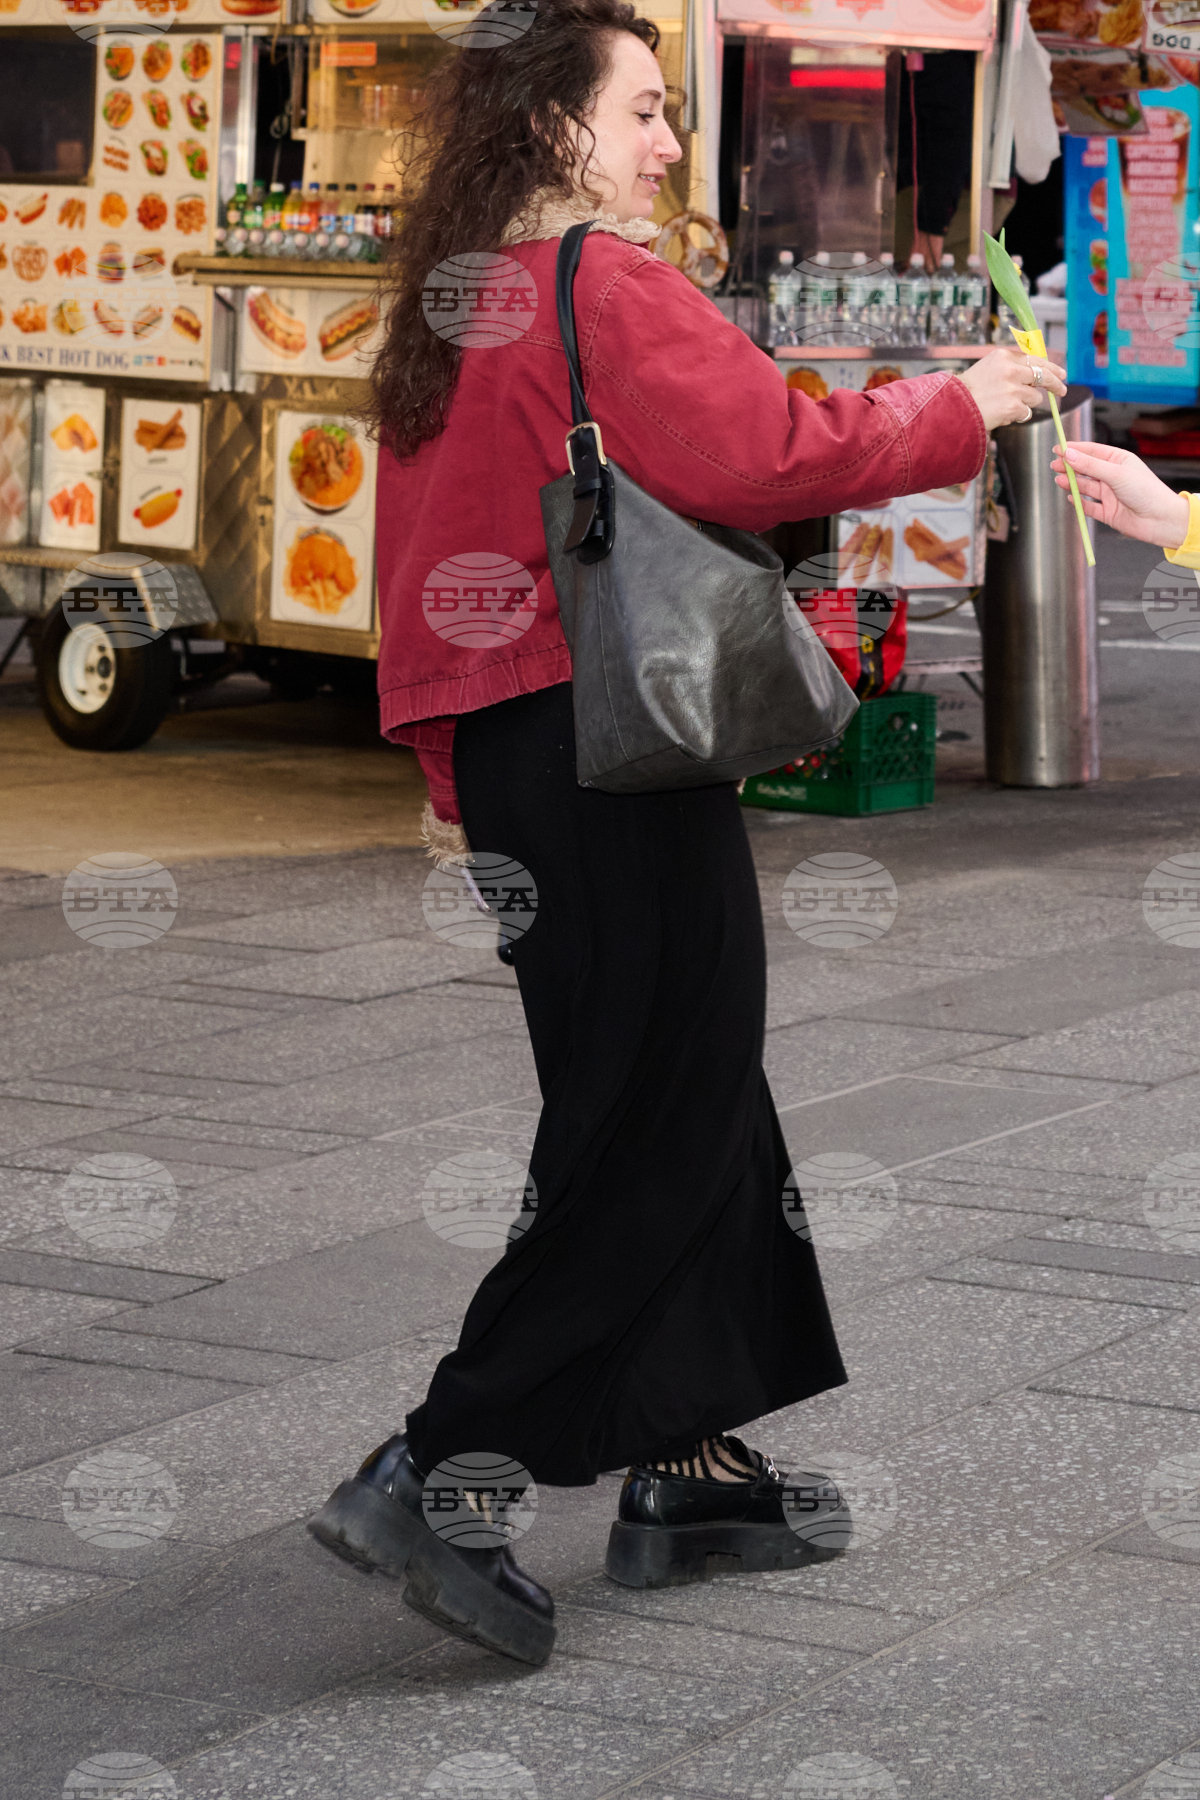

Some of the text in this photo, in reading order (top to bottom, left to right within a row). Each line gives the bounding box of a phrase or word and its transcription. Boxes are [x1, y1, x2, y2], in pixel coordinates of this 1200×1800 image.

[1152, 34, 1191, 49] DOG
[17, 347, 53, 365] BEST
[59, 349, 91, 367] HOT
[96, 352, 130, 370] DOG
